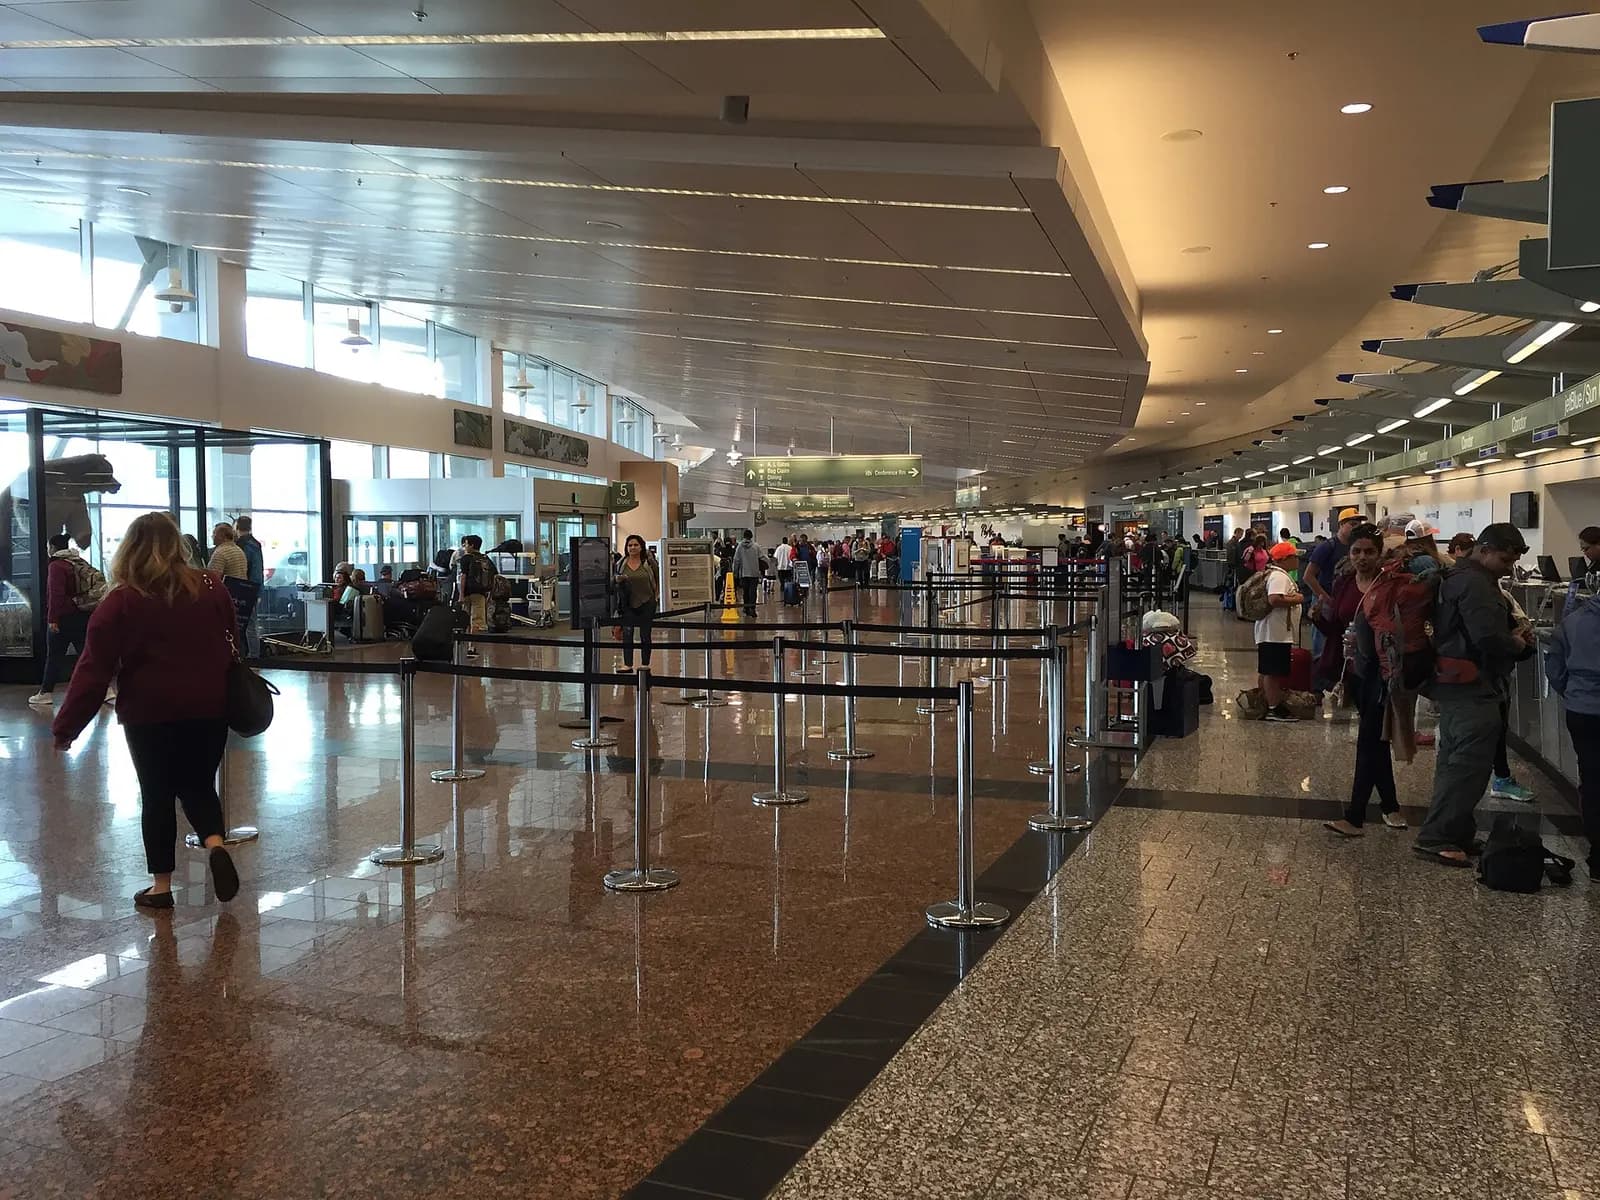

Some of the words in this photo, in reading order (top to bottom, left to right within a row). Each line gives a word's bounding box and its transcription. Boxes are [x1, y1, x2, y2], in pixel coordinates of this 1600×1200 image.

[1511, 415, 1527, 433] Condor
[620, 483, 628, 497] 5
[616, 497, 631, 505] Door
